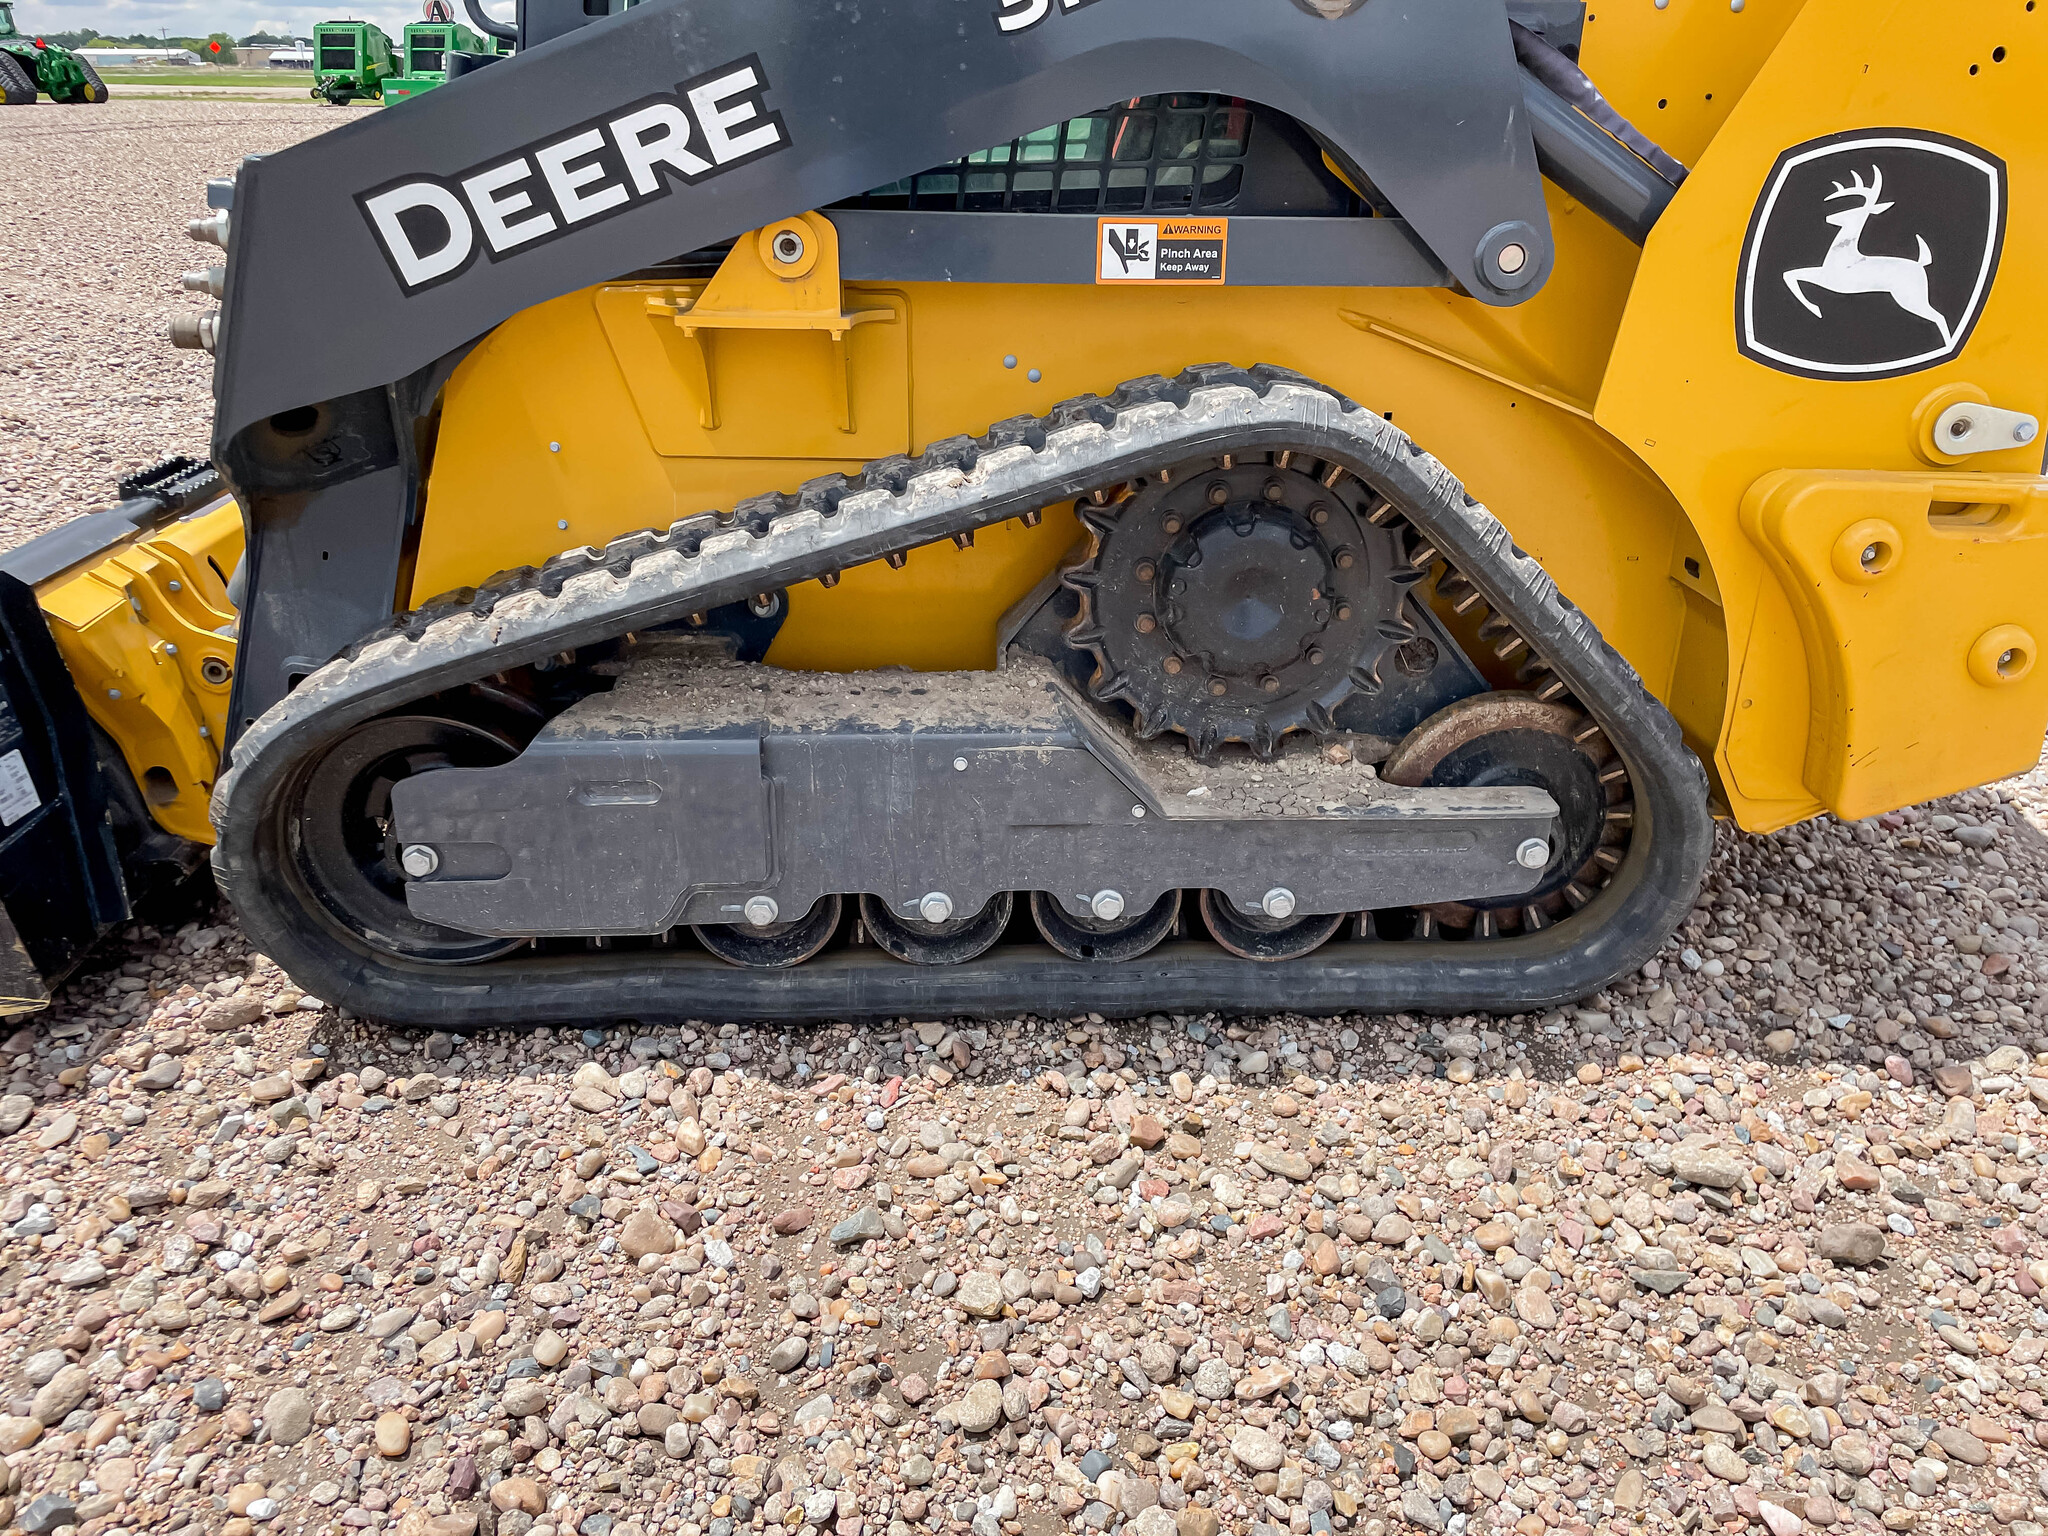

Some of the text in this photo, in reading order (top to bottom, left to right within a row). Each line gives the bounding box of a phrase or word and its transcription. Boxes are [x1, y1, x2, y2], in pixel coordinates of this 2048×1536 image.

[365, 66, 781, 287] DEERE
[1174, 225, 1221, 234] WARNING
[1160, 248, 1218, 259] Pinch Area
[1160, 263, 1210, 273] Keep Away
